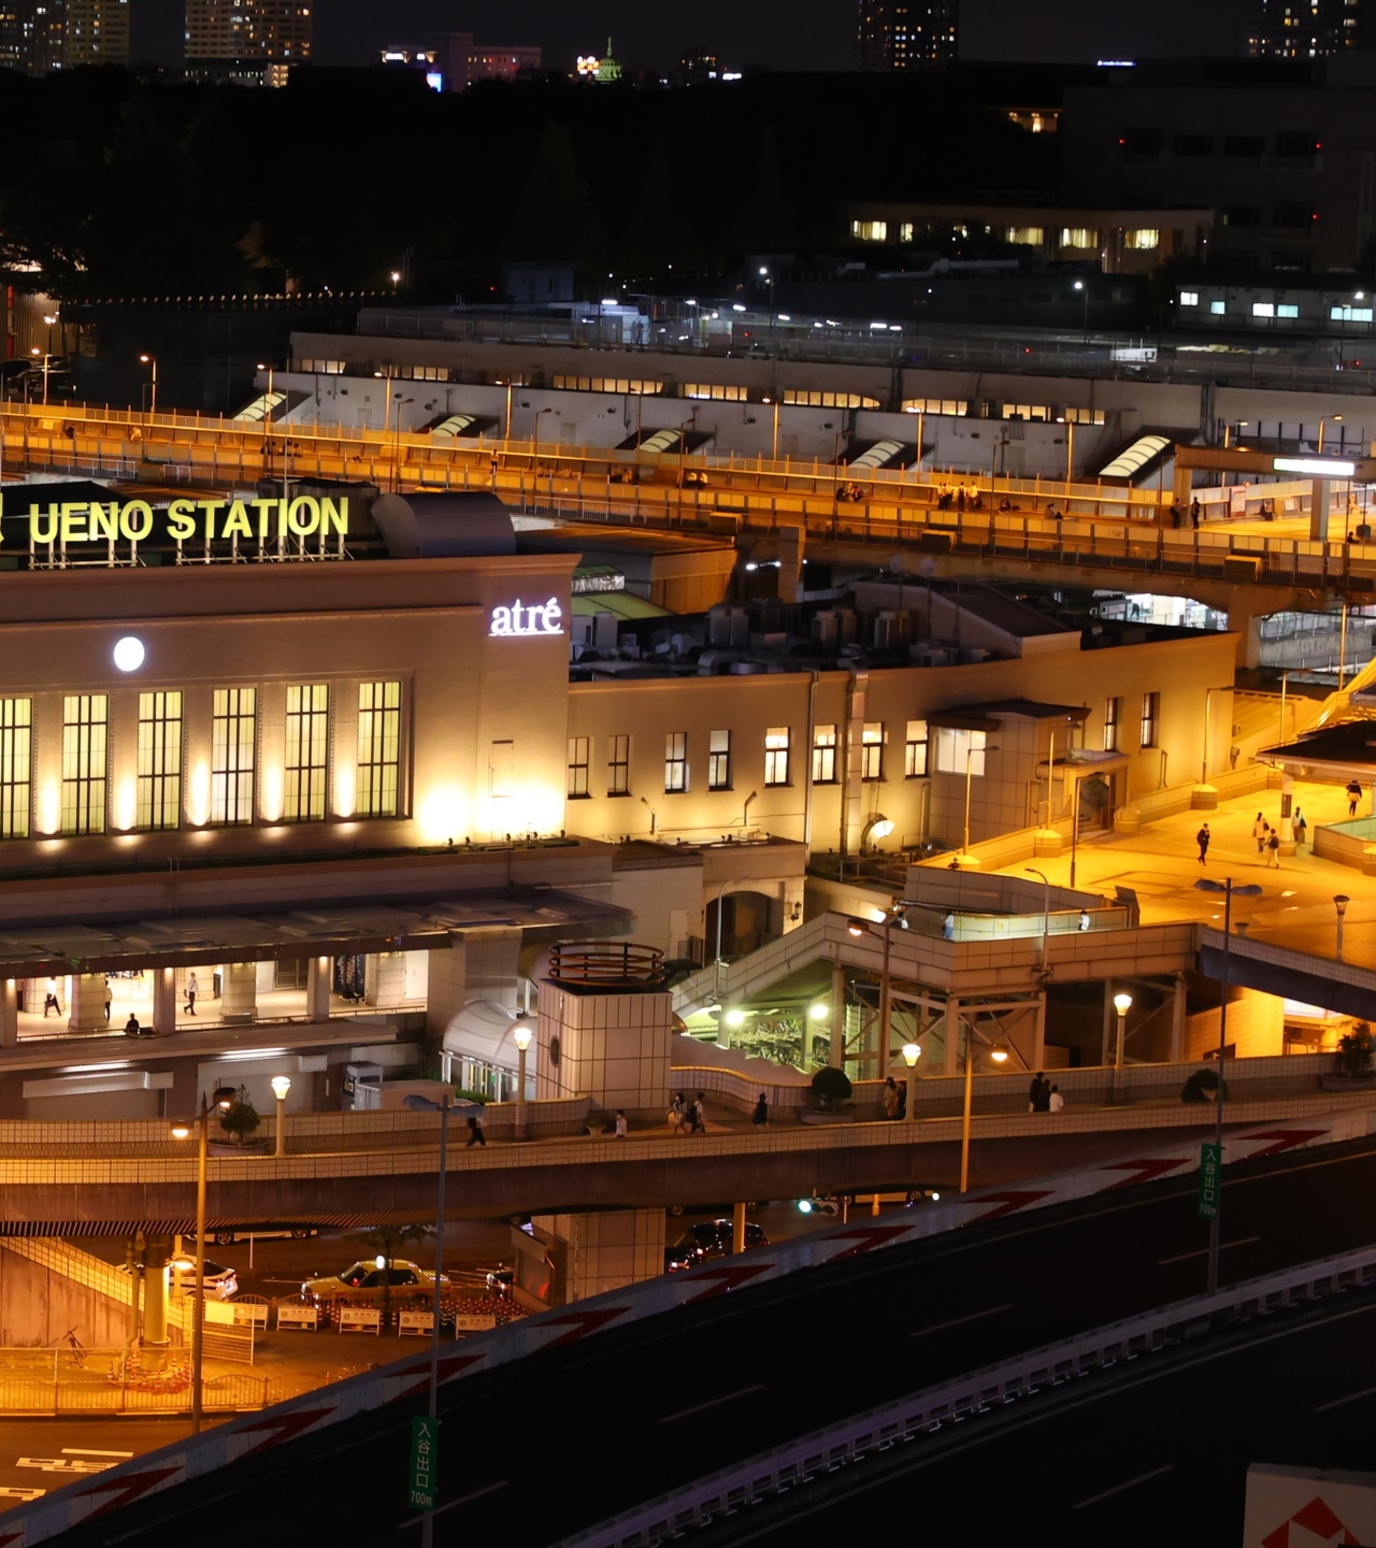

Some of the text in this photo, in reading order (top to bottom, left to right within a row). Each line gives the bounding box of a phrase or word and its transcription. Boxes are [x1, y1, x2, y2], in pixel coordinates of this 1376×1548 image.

[29, 501, 153, 544] UENO
[167, 496, 349, 540] STATION
[490, 597, 562, 634] atré
[1204, 1149, 1216, 1201] 入谷出口
[416, 1422, 431, 1488] 入谷出口
[411, 1490, 432, 1506] 700m
